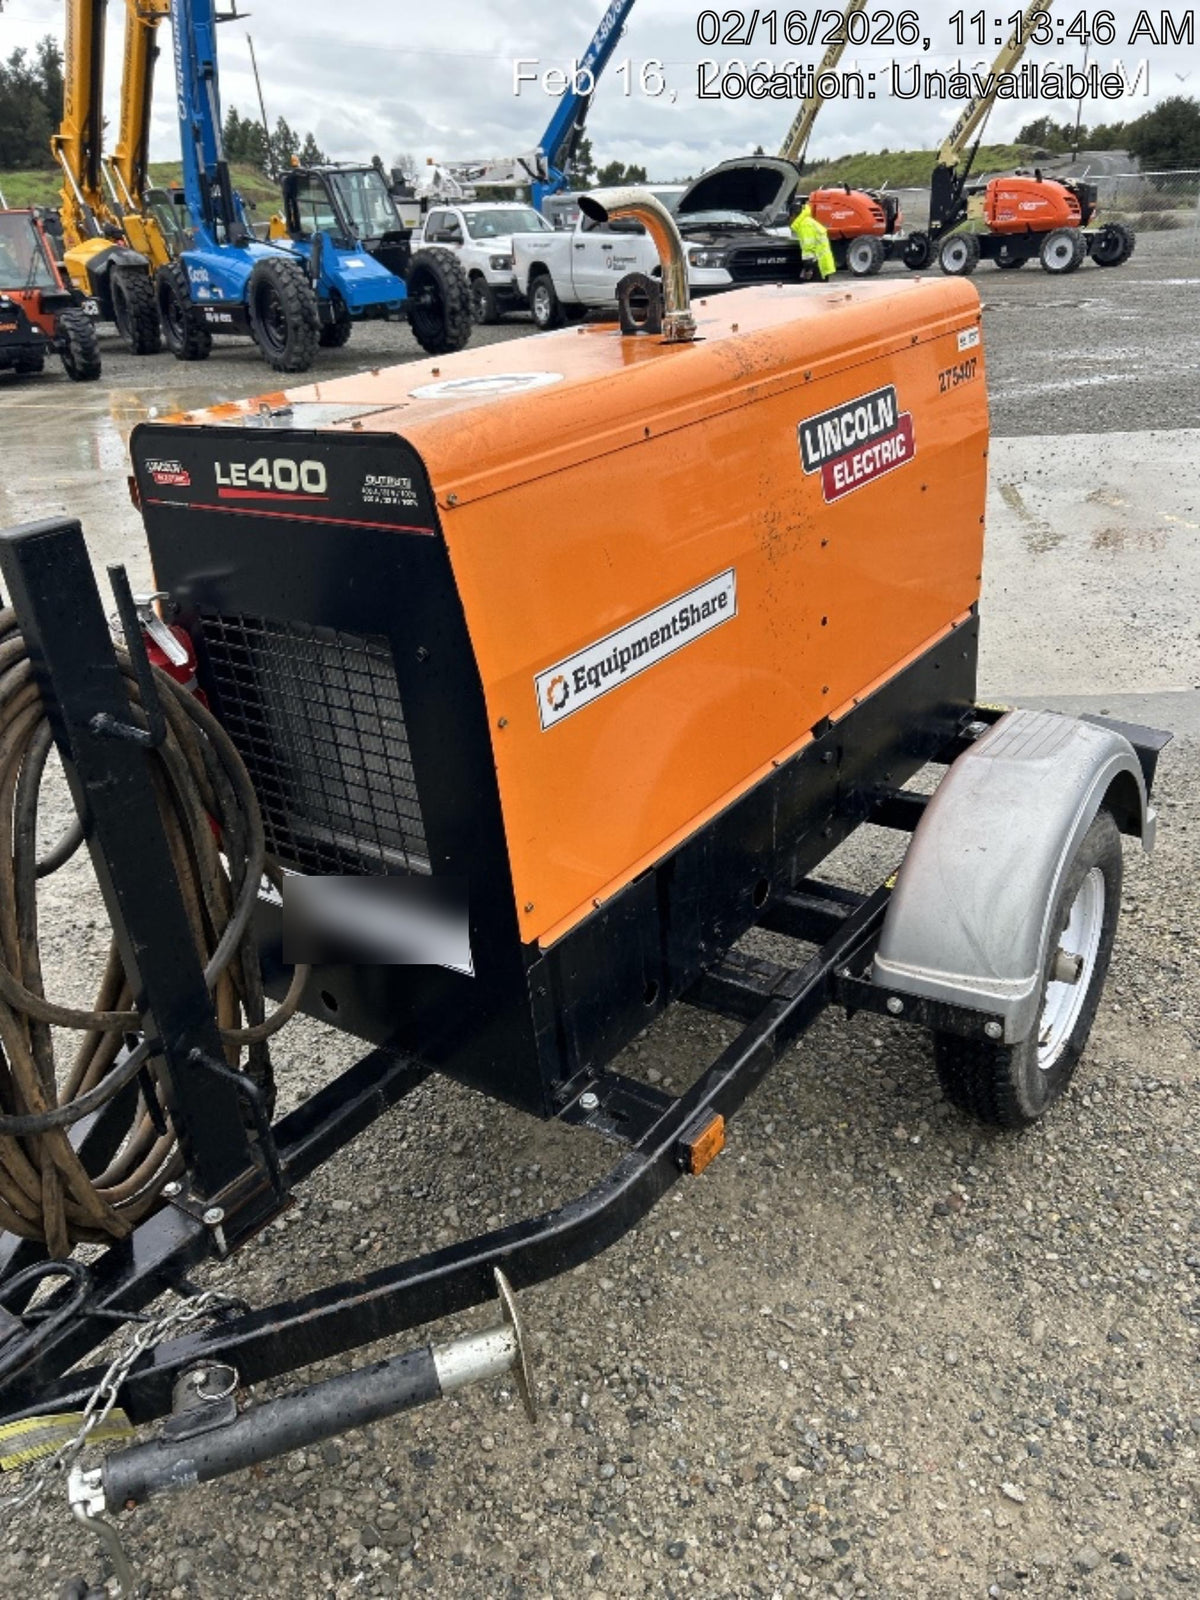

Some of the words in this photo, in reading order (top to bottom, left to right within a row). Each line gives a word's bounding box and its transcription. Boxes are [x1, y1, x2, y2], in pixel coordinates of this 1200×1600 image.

[804, 394, 894, 465] LINCOLN
[833, 432, 906, 490] ELECTRIC
[214, 457, 328, 493] LE400
[571, 590, 729, 695] EquipmentShare
